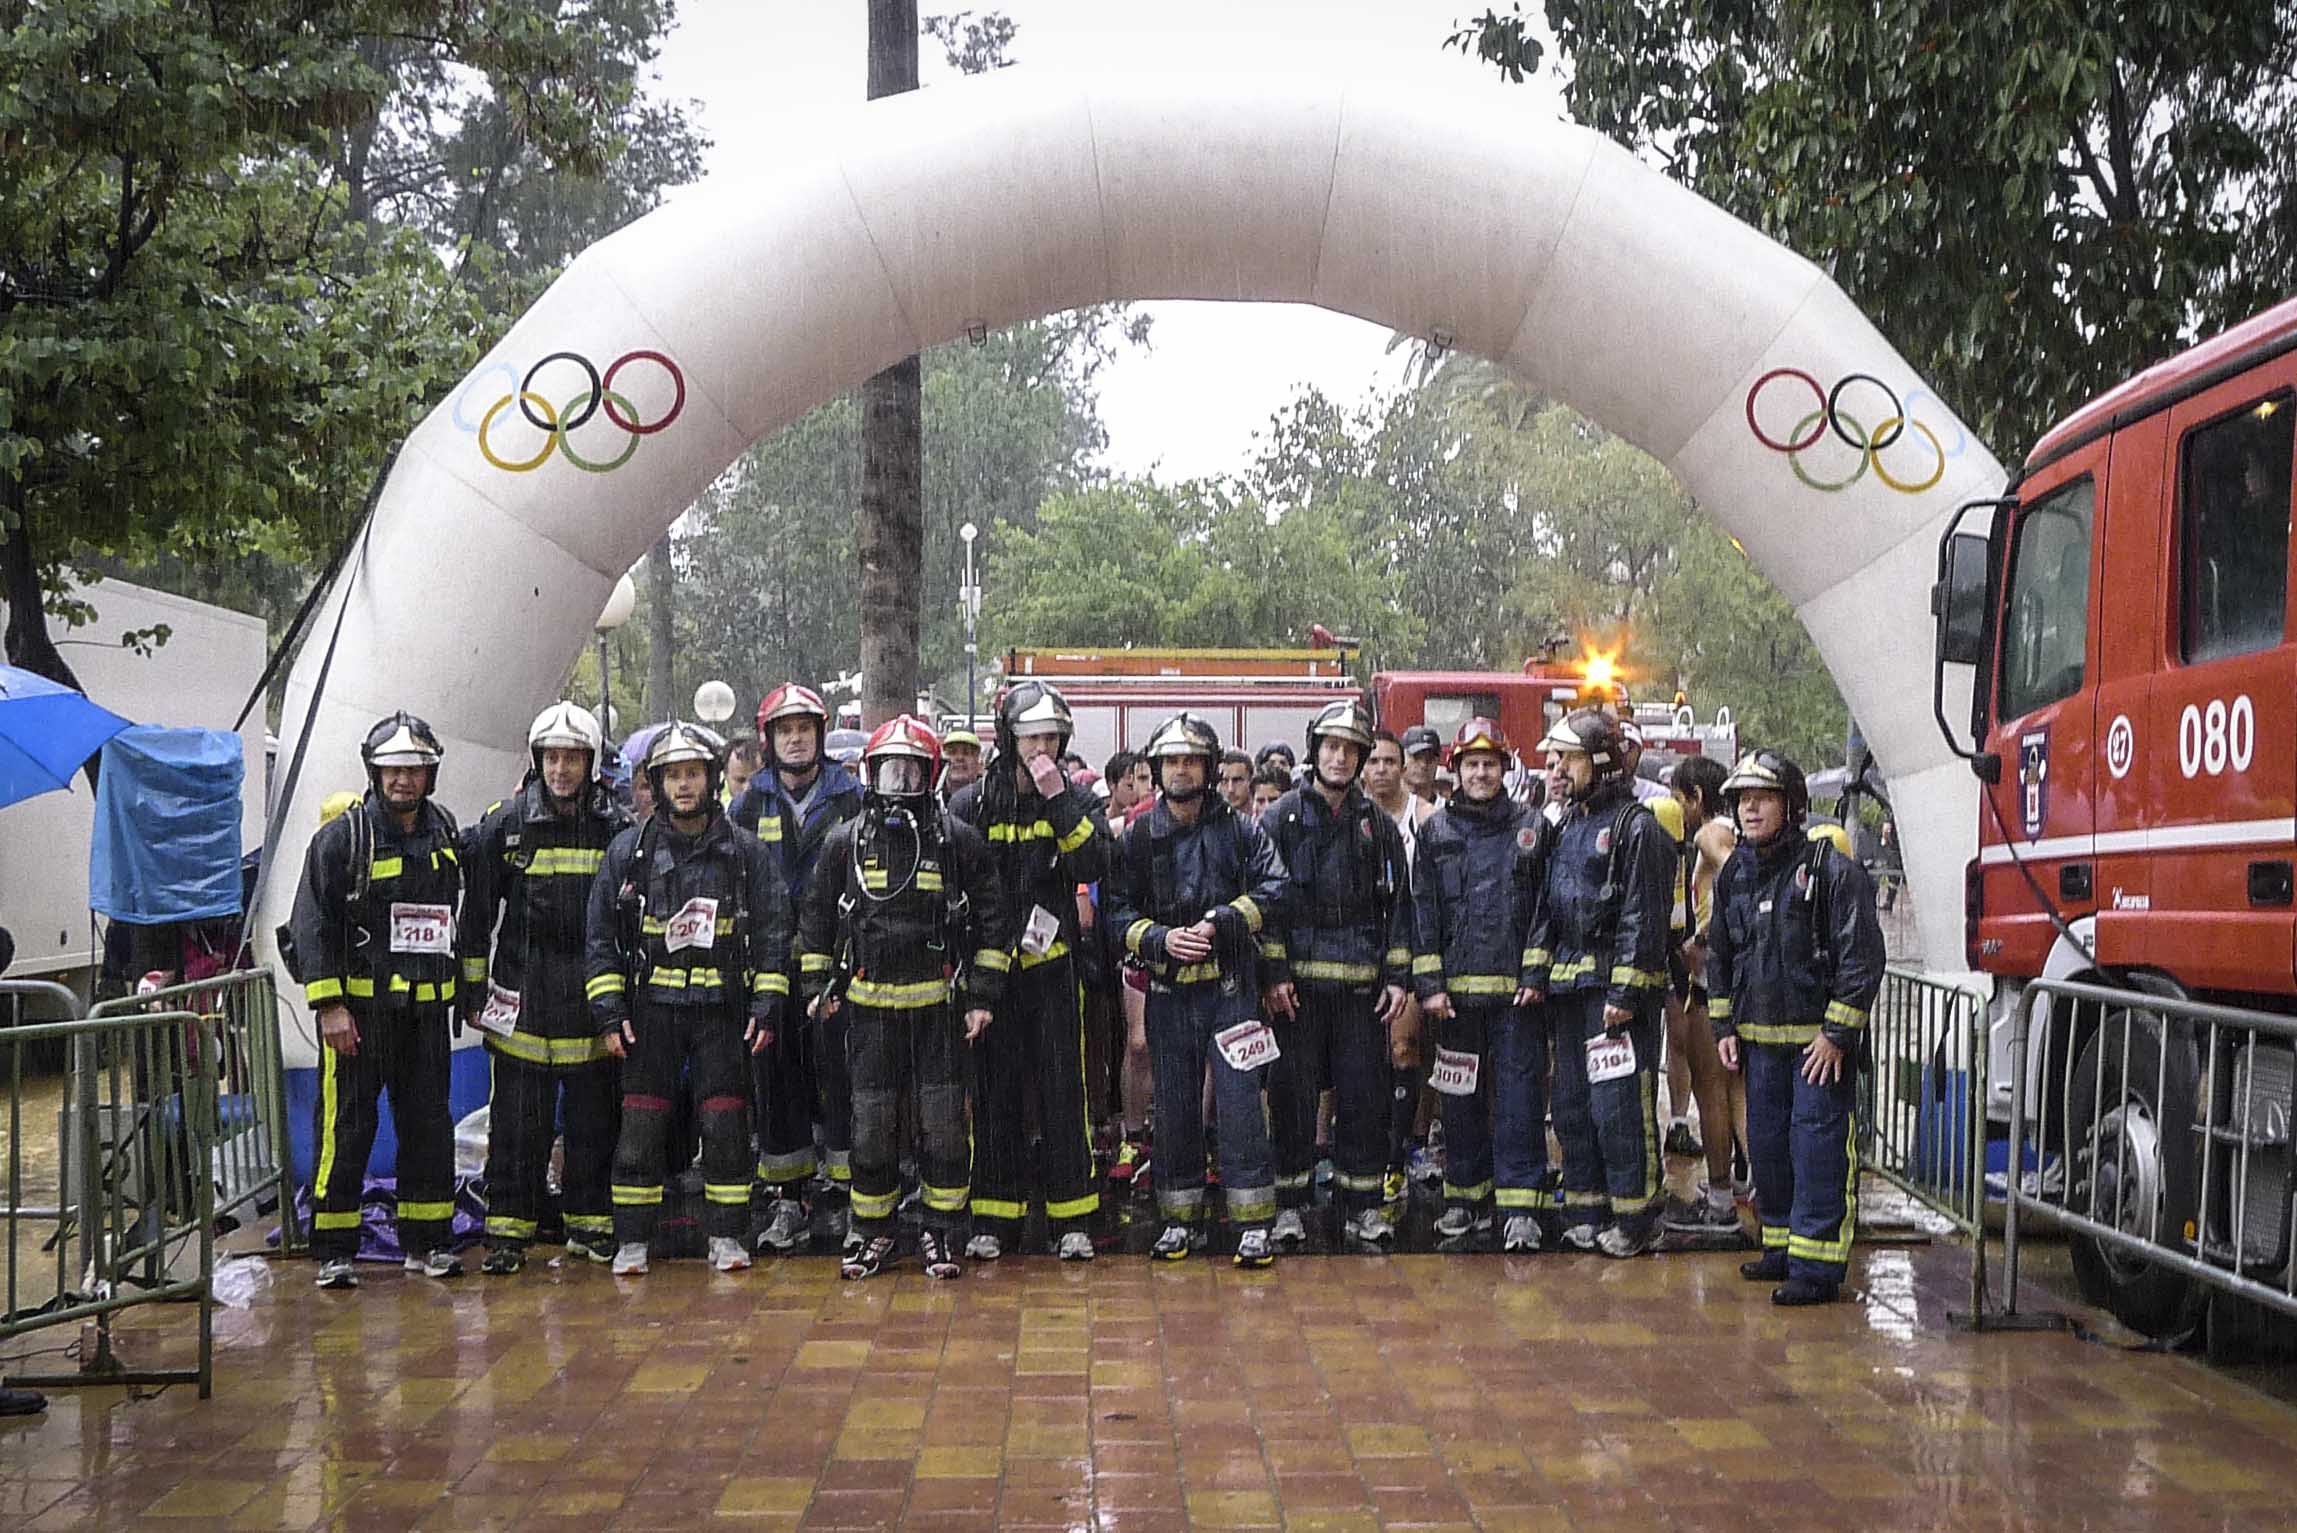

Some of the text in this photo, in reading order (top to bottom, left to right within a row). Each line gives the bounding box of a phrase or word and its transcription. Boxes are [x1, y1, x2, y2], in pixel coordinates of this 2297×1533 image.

[2112, 729, 2128, 763] 27
[2179, 693, 2255, 779] 080
[1237, 1040, 1265, 1063] 249
